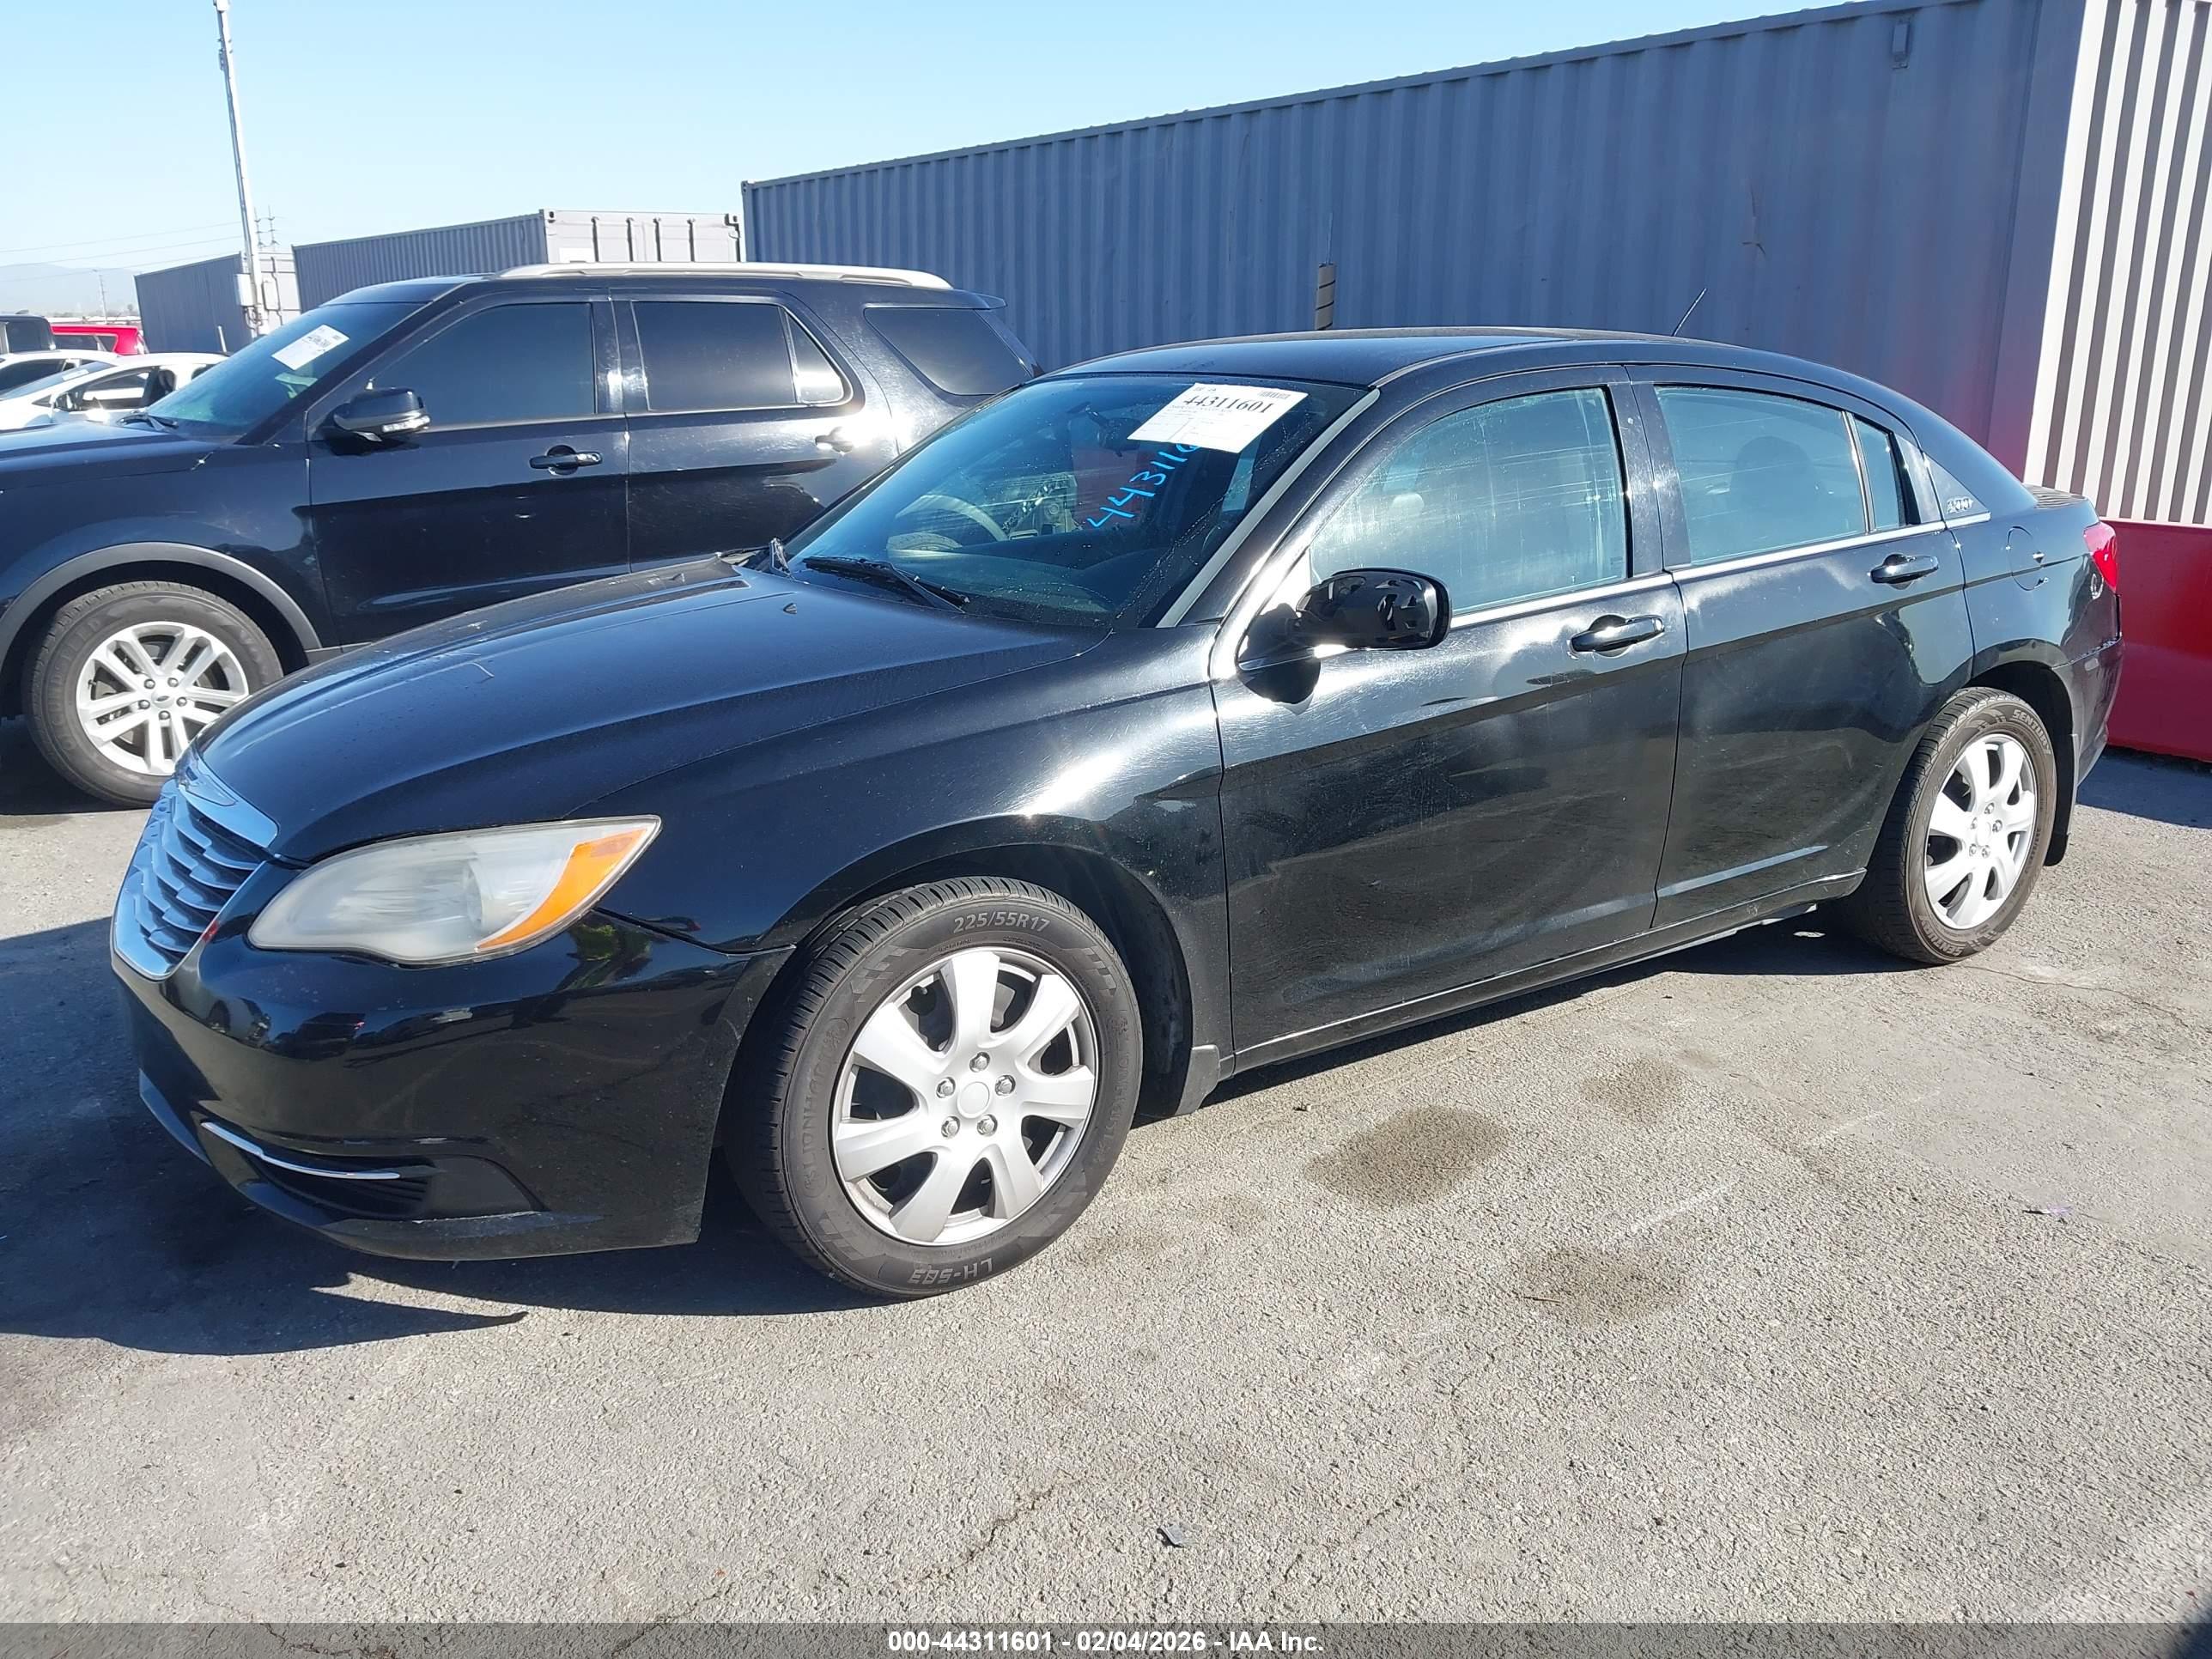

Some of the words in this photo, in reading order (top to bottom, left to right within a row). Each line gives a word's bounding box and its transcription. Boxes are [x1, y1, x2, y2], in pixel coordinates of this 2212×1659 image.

[1183, 395, 1273, 413] 44311601
[2010, 708, 2052, 757] SENTURY
[953, 911, 1050, 933] 225/55R17
[906, 1258, 993, 1284] LH-503
